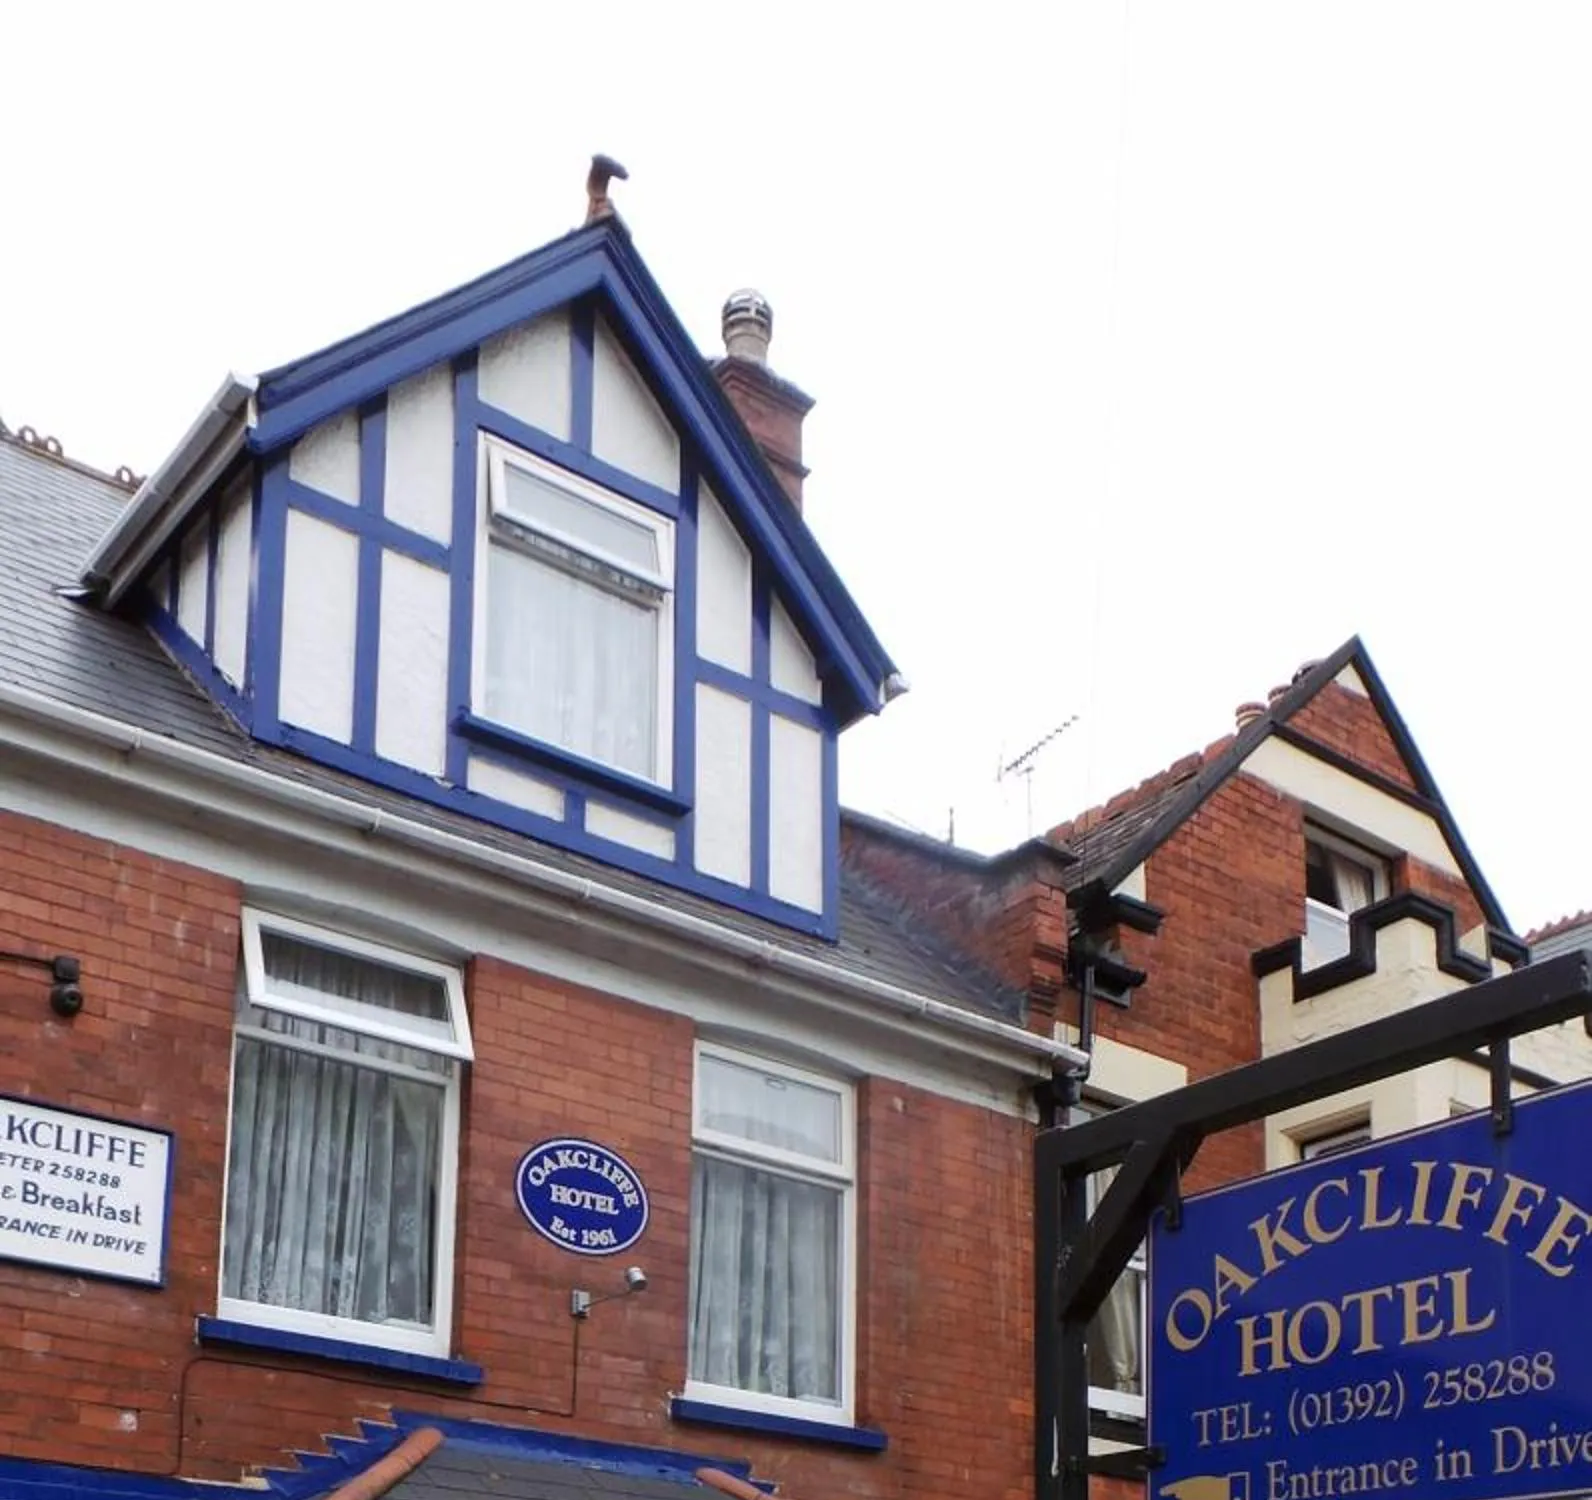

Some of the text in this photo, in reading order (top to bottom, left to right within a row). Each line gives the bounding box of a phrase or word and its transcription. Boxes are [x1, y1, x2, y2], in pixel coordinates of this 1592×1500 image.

[0, 1114, 147, 1169] KCLIFFE
[49, 1161, 121, 1189] 258288
[528, 1150, 639, 1208] OAKCLIFFE
[550, 1183, 619, 1215] HOTEL
[22, 1180, 143, 1226] Breakfast
[66, 1228, 89, 1246] IN
[93, 1233, 147, 1256] DRIVE
[551, 1216, 618, 1247] Est 1961
[1165, 1160, 1592, 1352] OAKCLIFFE
[1237, 1267, 1496, 1378] HOTEL
[1192, 1350, 1556, 1447] TEL: (01392) 258288
[1434, 1438, 1474, 1482] in
[1490, 1421, 1592, 1474] Drive
